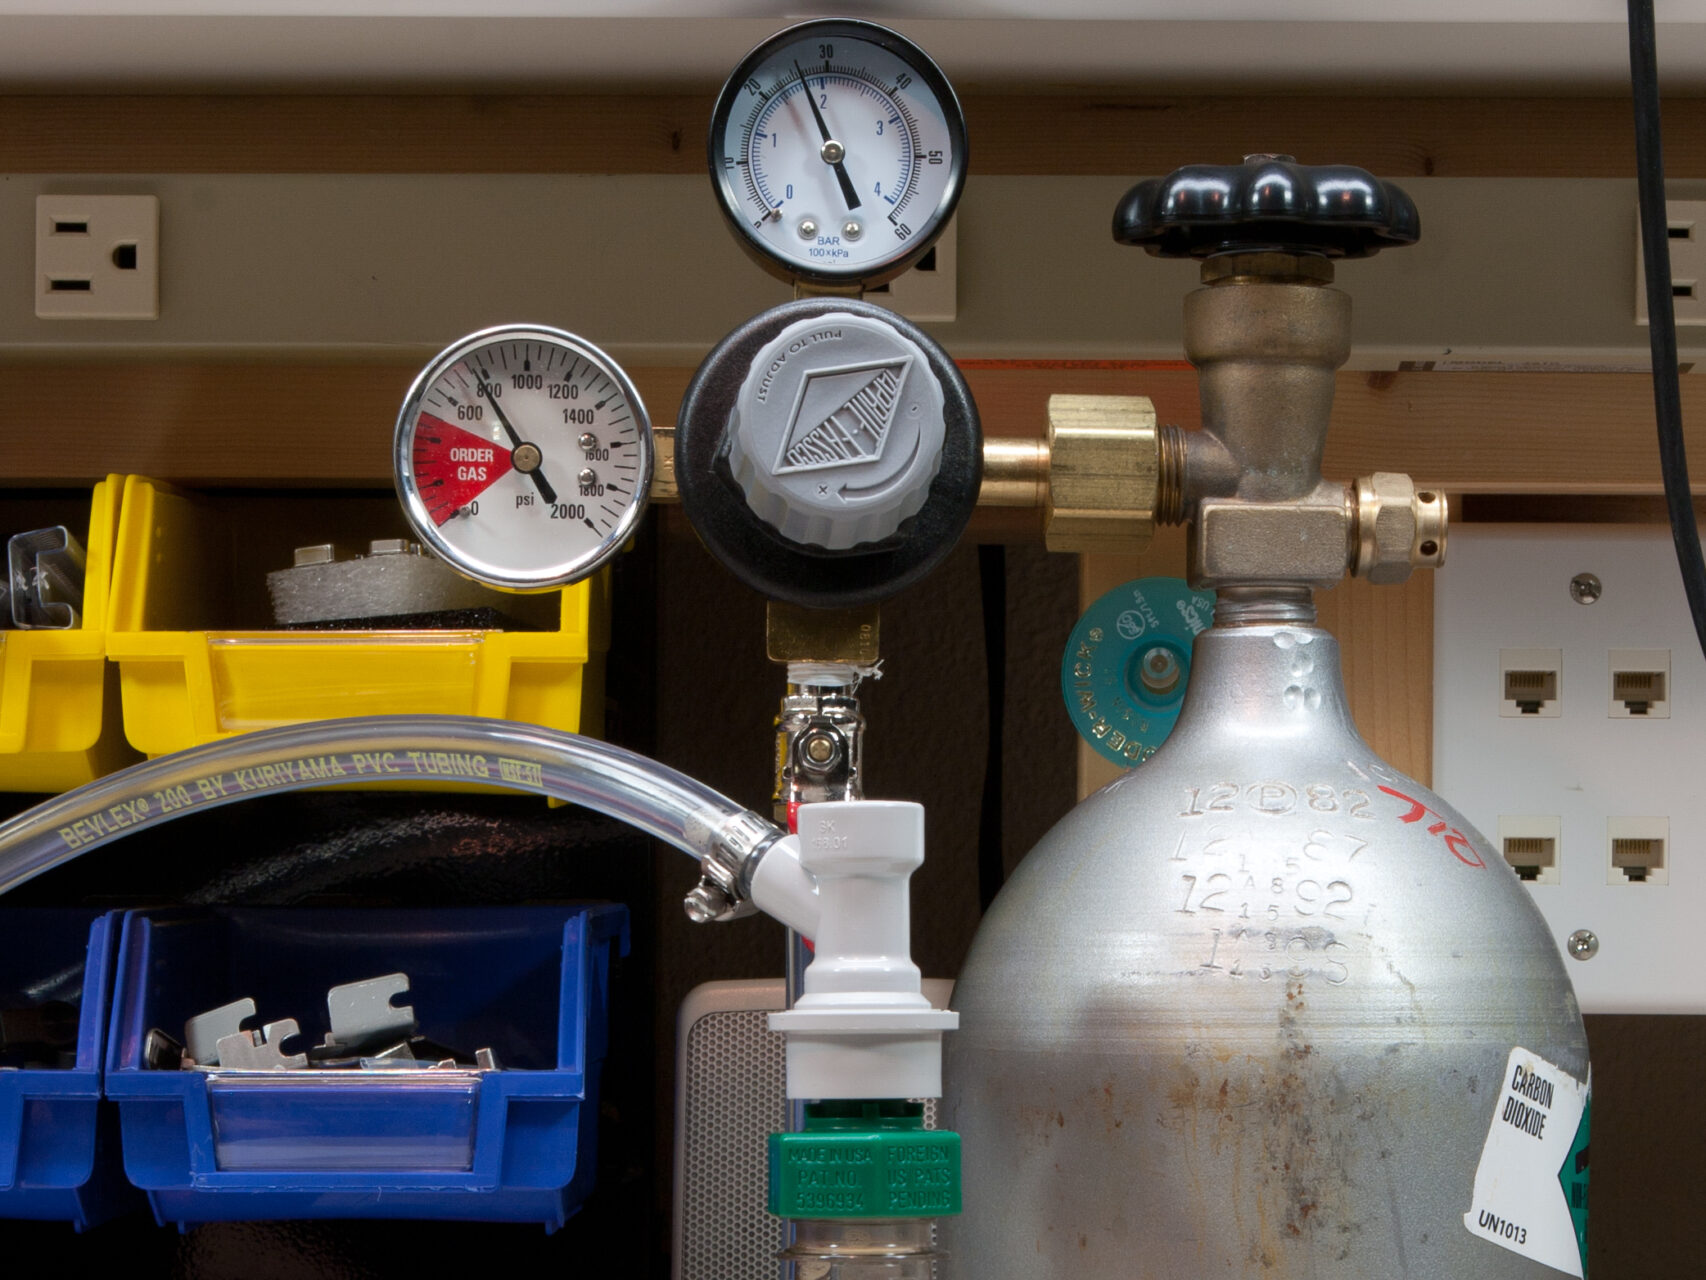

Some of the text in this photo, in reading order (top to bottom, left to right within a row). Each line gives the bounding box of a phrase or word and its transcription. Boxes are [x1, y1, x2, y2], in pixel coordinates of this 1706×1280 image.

[819, 45, 833, 59] 30
[743, 79, 761, 97] 20
[895, 72, 912, 89] 40
[820, 95, 827, 109] 2
[877, 121, 883, 136] 3
[772, 133, 777, 148] 1
[928, 150, 943, 165] 50
[786, 184, 793, 200] 0
[874, 182, 881, 197] 4
[817, 236, 840, 246] BAR
[894, 225, 912, 241] 60
[757, 329, 842, 402] PULL TO ADJUST
[511, 374, 543, 390] 1000
[476, 383, 502, 398] 800
[547, 384, 579, 400] 1200
[457, 405, 483, 421] 600
[563, 409, 594, 425] 1400
[450, 448, 494, 463] ORDER
[585, 448, 609, 462] 1600
[457, 466, 487, 482] GAS
[579, 483, 604, 497] 1800
[516, 491, 534, 508] psi
[471, 501, 479, 516] 0
[550, 503, 585, 520] 2000
[154, 784, 192, 813] 200
[197, 775, 229, 801] BY
[233, 755, 346, 792] KURIYAMA
[352, 752, 400, 775] PVC
[406, 751, 490, 778] TUBING
[1512, 1064, 1555, 1110] CARBON
[1502, 1095, 1547, 1141] DIOXIDE
[788, 1147, 874, 1164] MADE IN USA
[887, 1145, 950, 1163] FOREIGN
[887, 1167, 951, 1187] US PATS
[795, 1191, 865, 1210] 5396934
[888, 1190, 951, 1209] PENDING
[1478, 1209, 1528, 1244] UN1013
